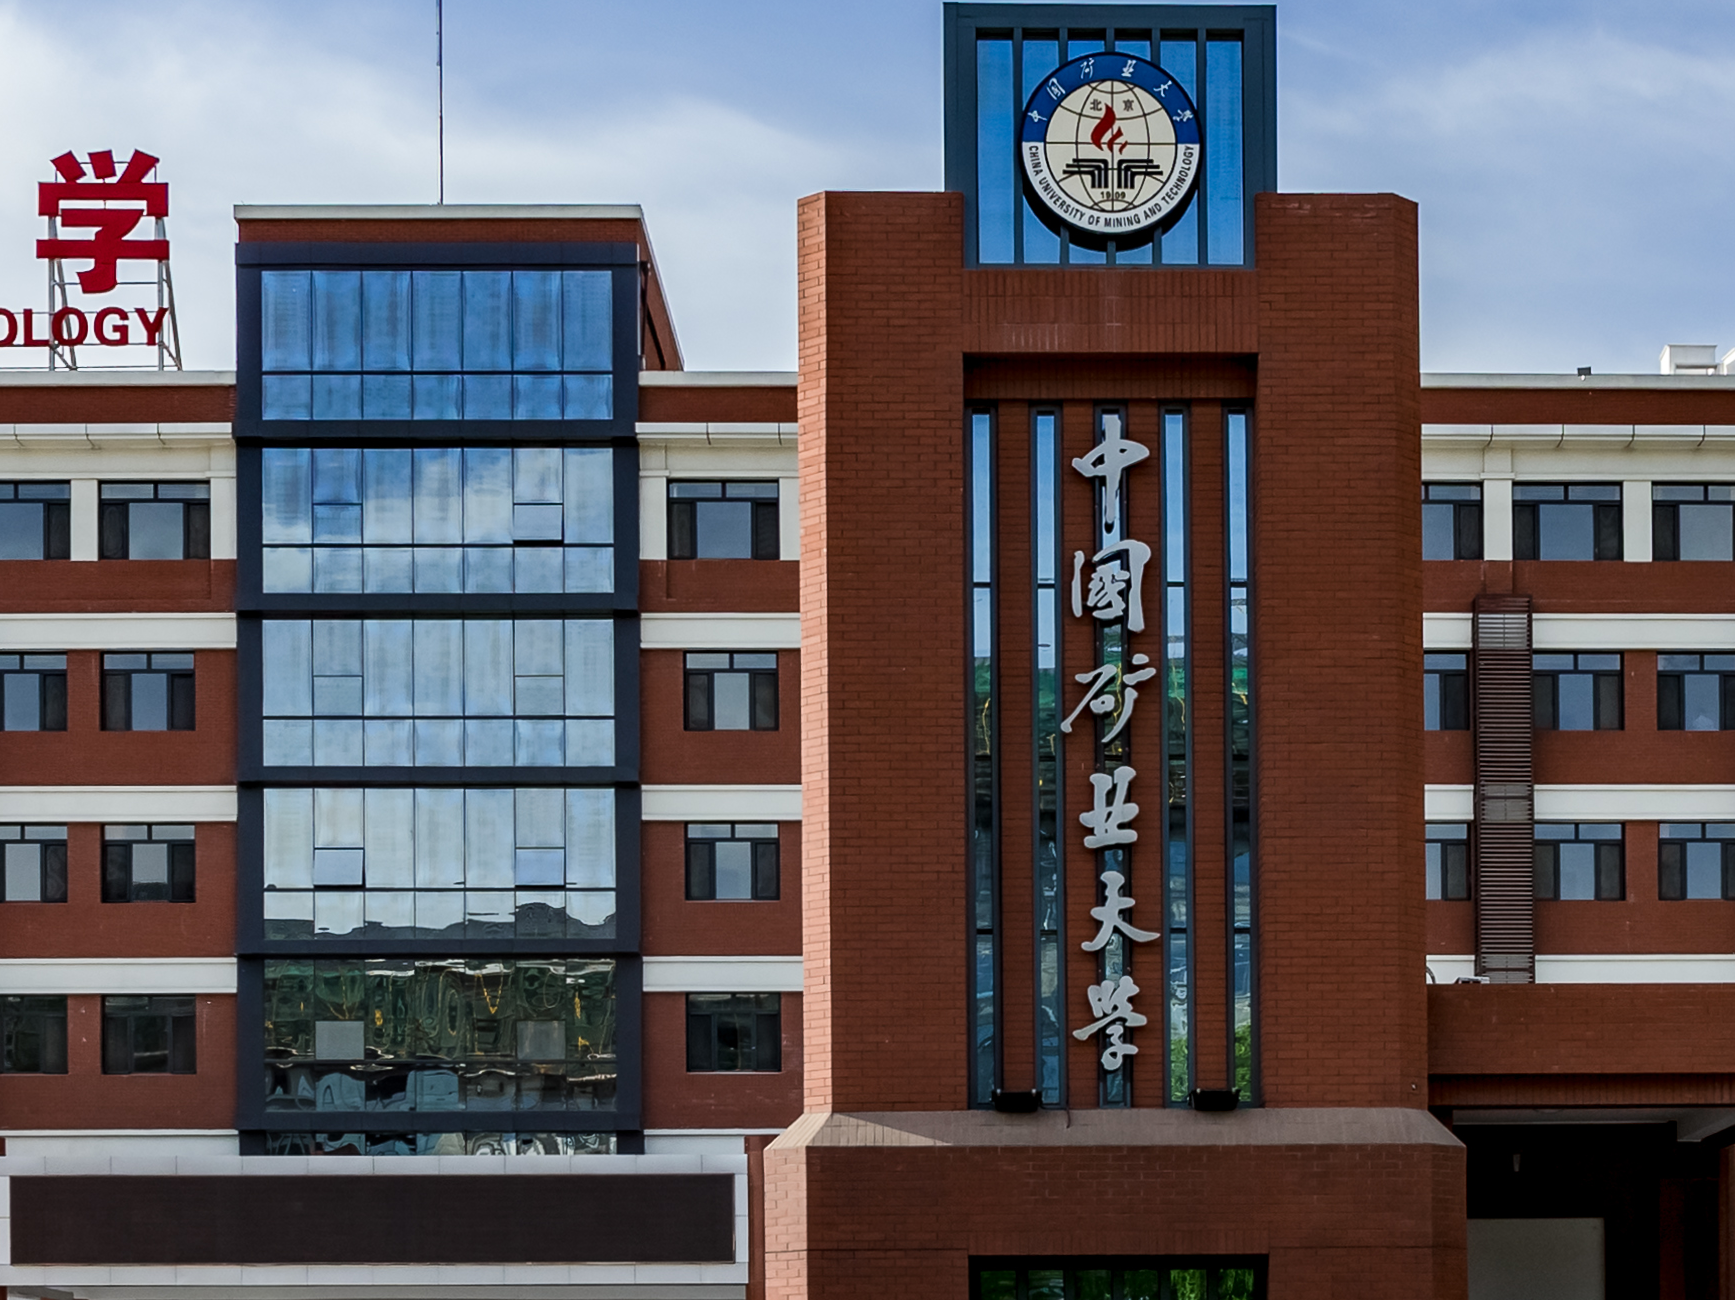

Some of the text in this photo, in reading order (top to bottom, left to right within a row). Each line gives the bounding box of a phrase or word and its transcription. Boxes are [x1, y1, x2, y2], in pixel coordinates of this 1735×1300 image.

[1028, 145, 1195, 228] CHINA UNIVERSITY OF MINING AND TECHNOLOGY
